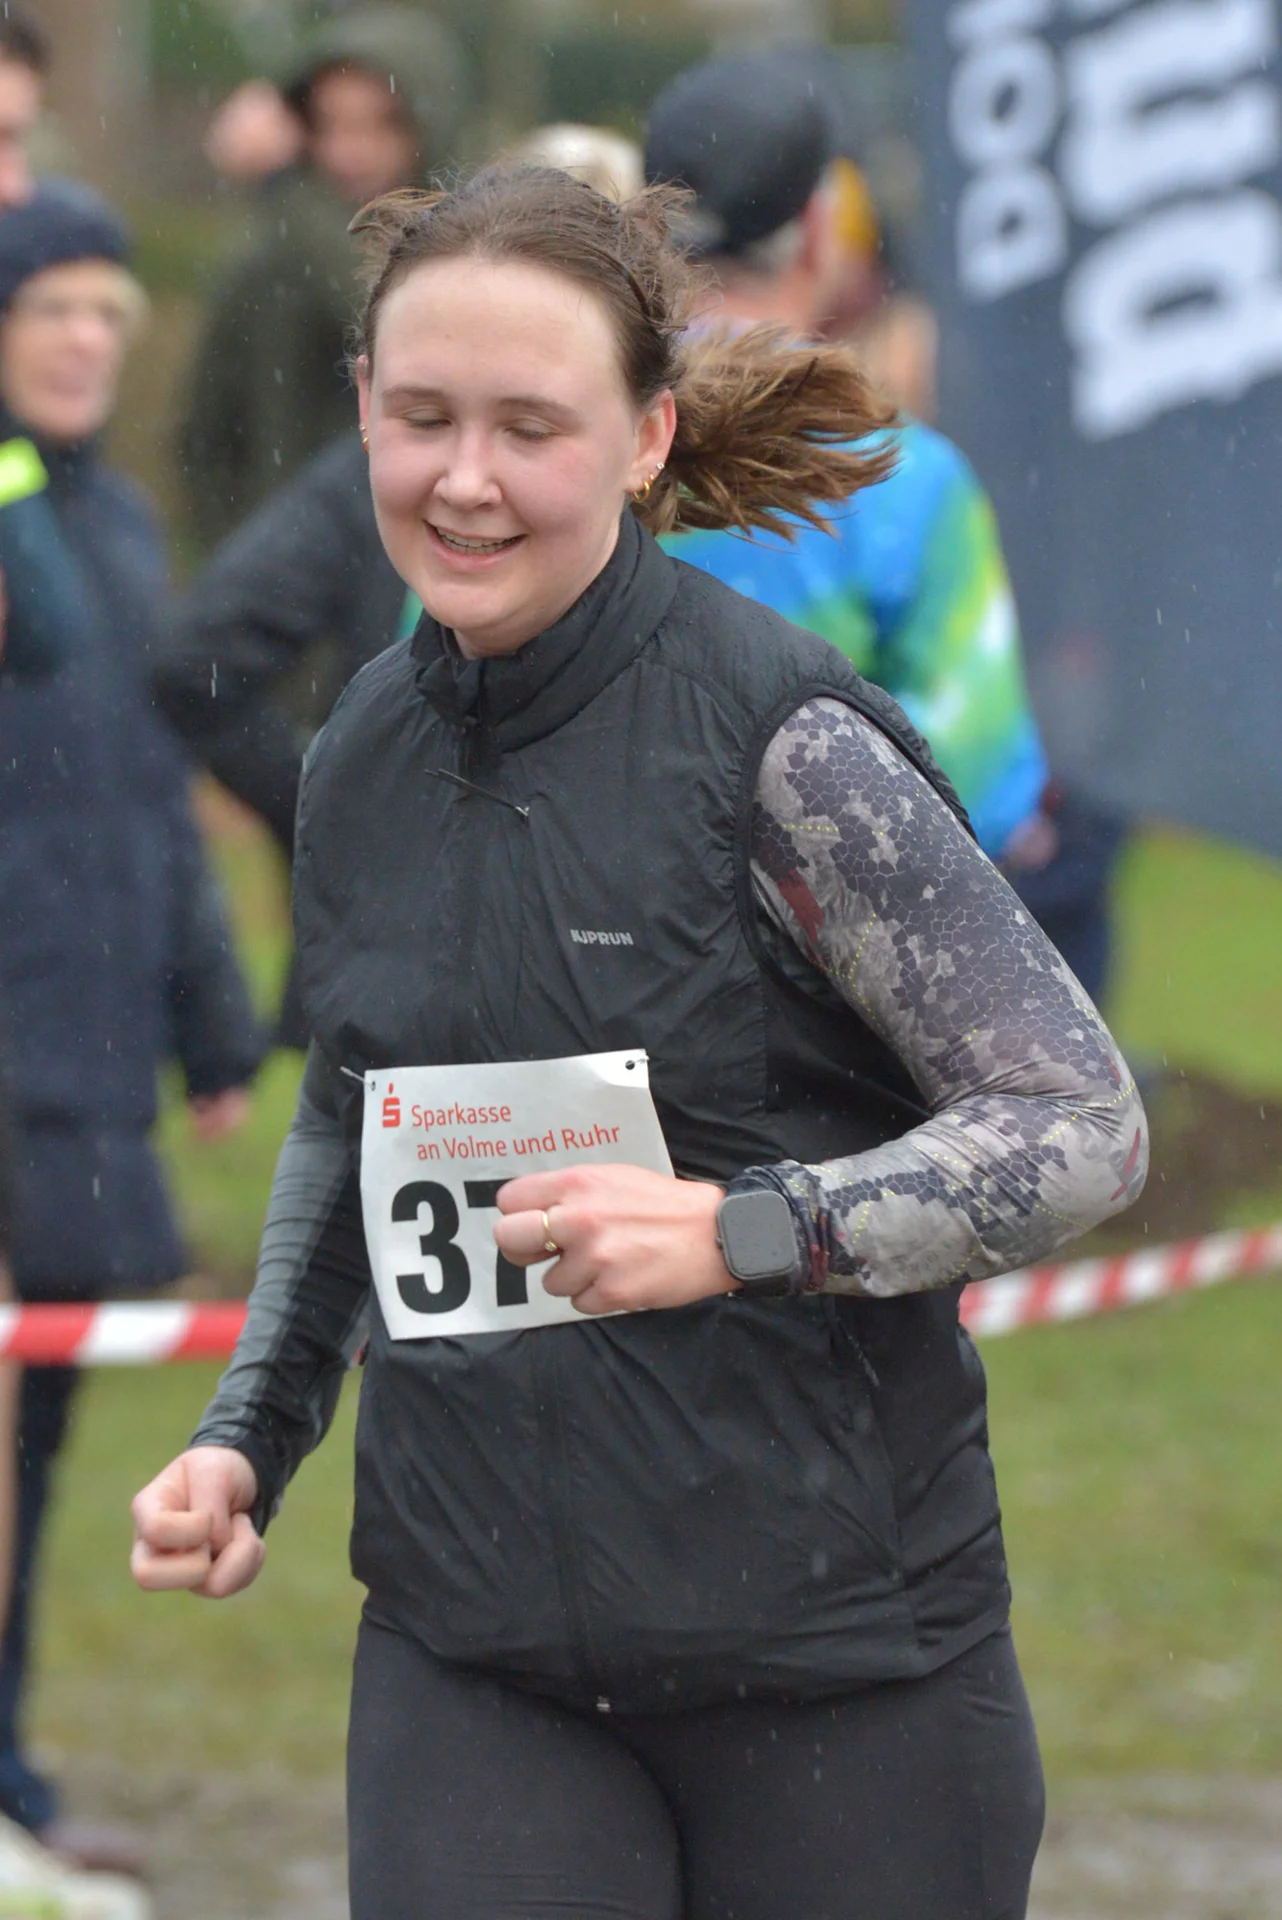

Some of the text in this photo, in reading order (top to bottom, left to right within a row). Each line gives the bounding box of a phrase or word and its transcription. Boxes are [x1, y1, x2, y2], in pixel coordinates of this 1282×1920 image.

[411, 1102, 512, 1132] Sparkasse
[416, 1123, 621, 1161] an Volme und Ruhr
